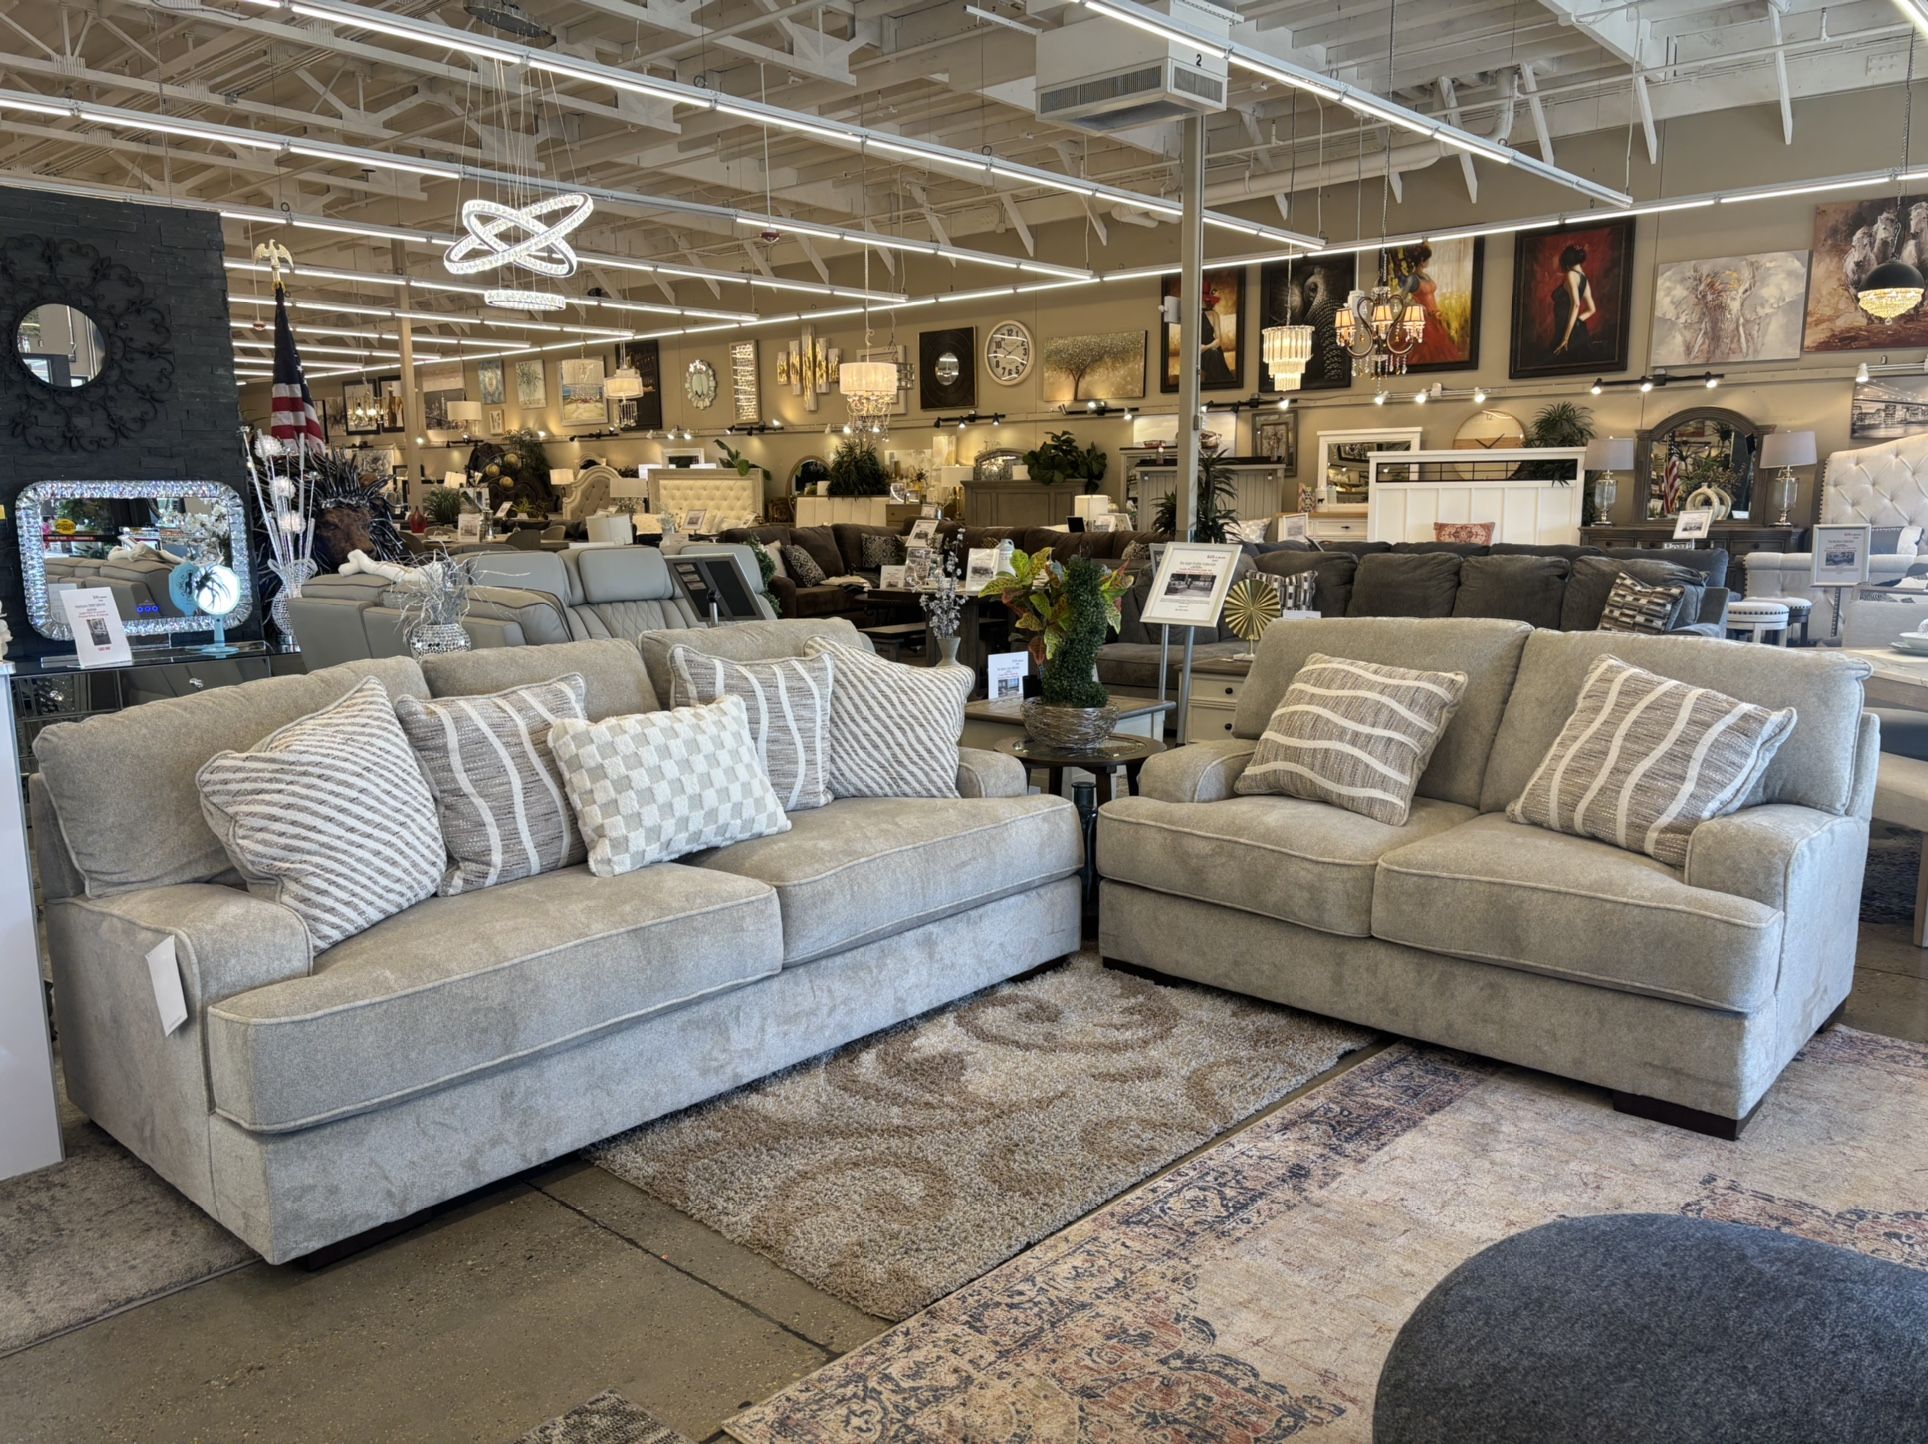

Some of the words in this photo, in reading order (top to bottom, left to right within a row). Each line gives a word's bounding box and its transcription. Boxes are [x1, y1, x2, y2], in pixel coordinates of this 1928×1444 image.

[1196, 54, 1201, 67] 2
[995, 340, 1002, 349] 10
[1023, 348, 1028, 356] 3
[1002, 367, 1006, 376] 7
[1015, 366, 1020, 375] 5
